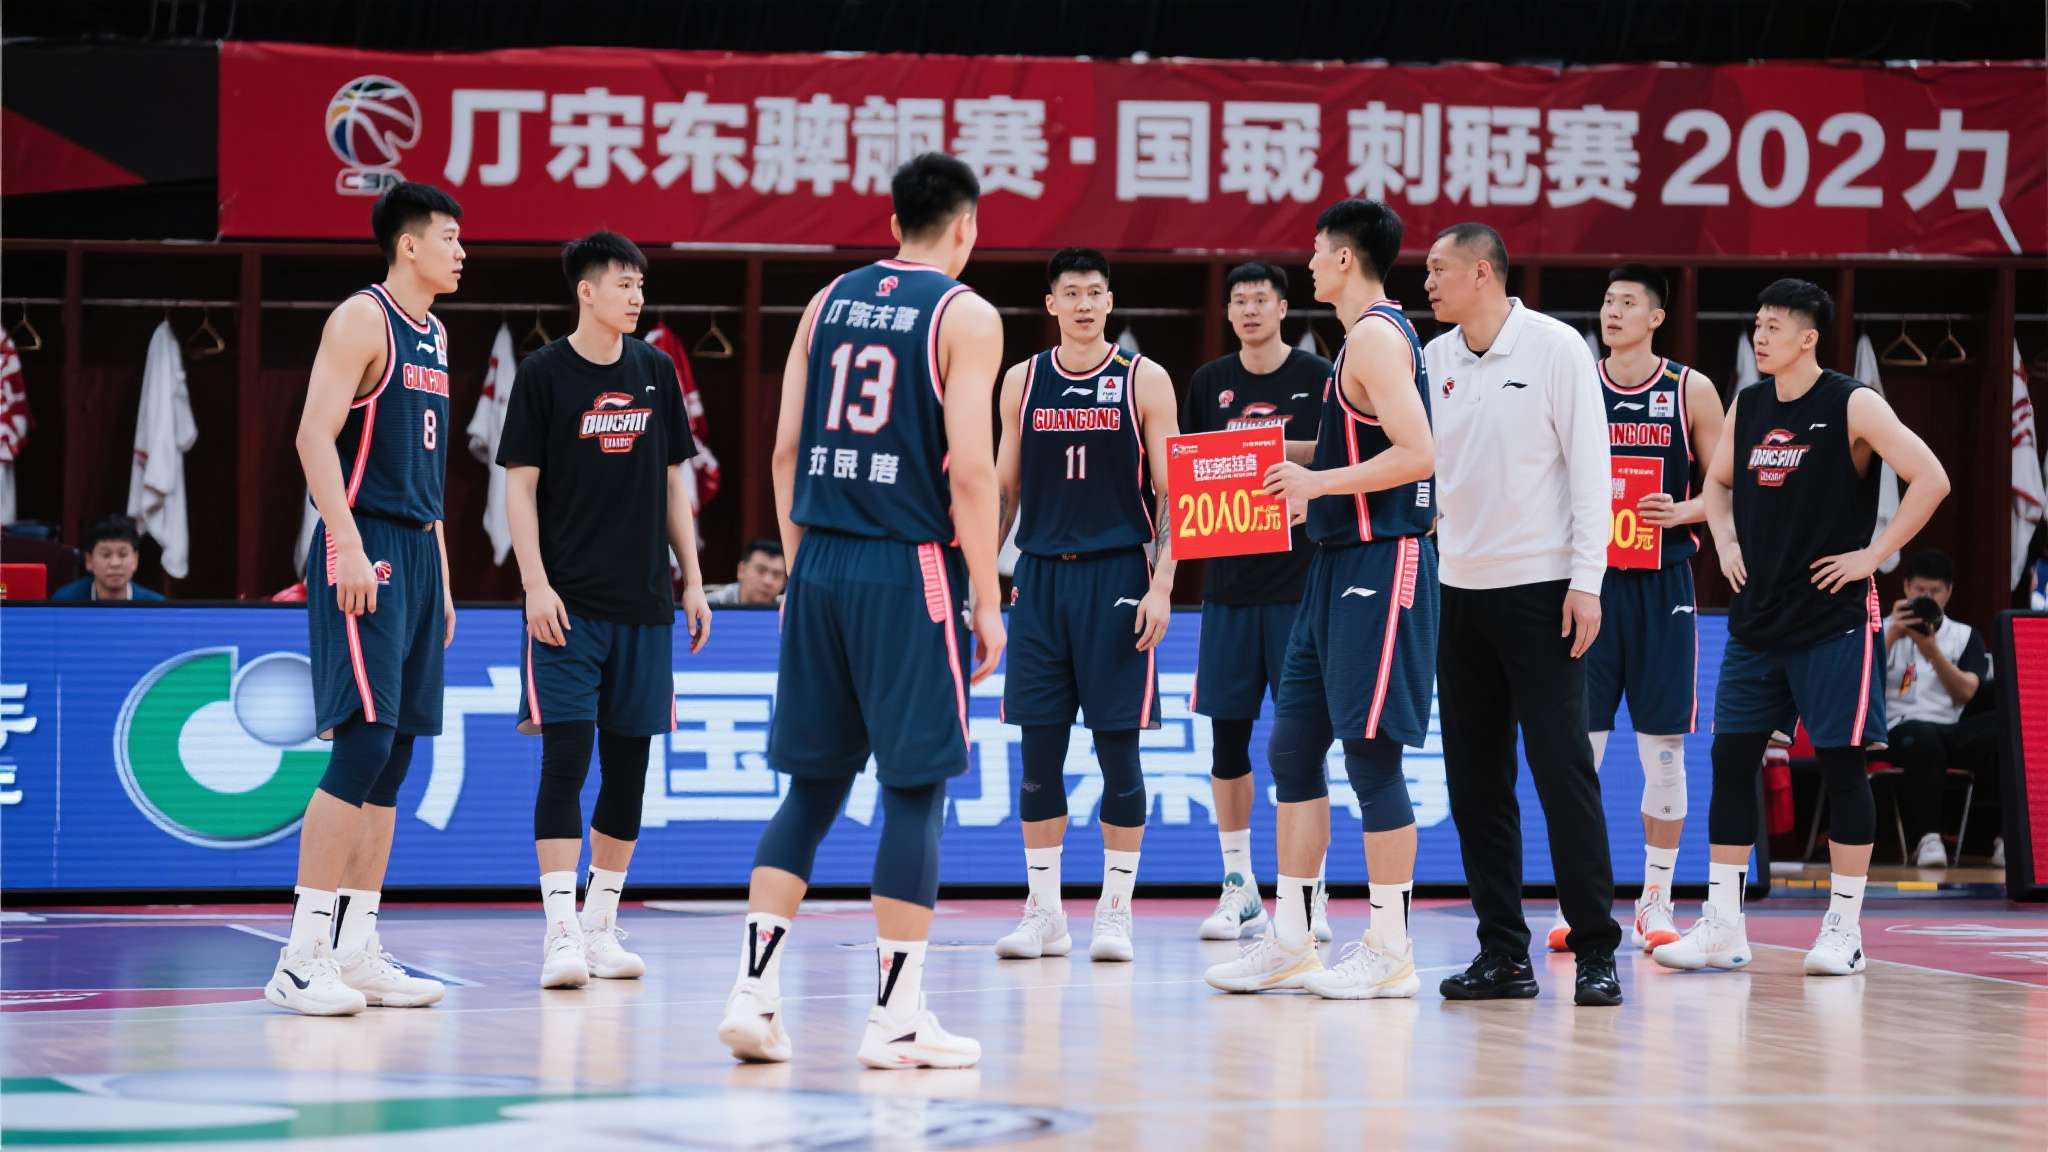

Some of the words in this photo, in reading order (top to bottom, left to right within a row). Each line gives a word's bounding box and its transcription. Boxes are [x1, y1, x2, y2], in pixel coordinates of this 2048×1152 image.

[826, 343, 896, 434] 13
[423, 409, 437, 450] 8
[1066, 445, 1086, 479] 11
